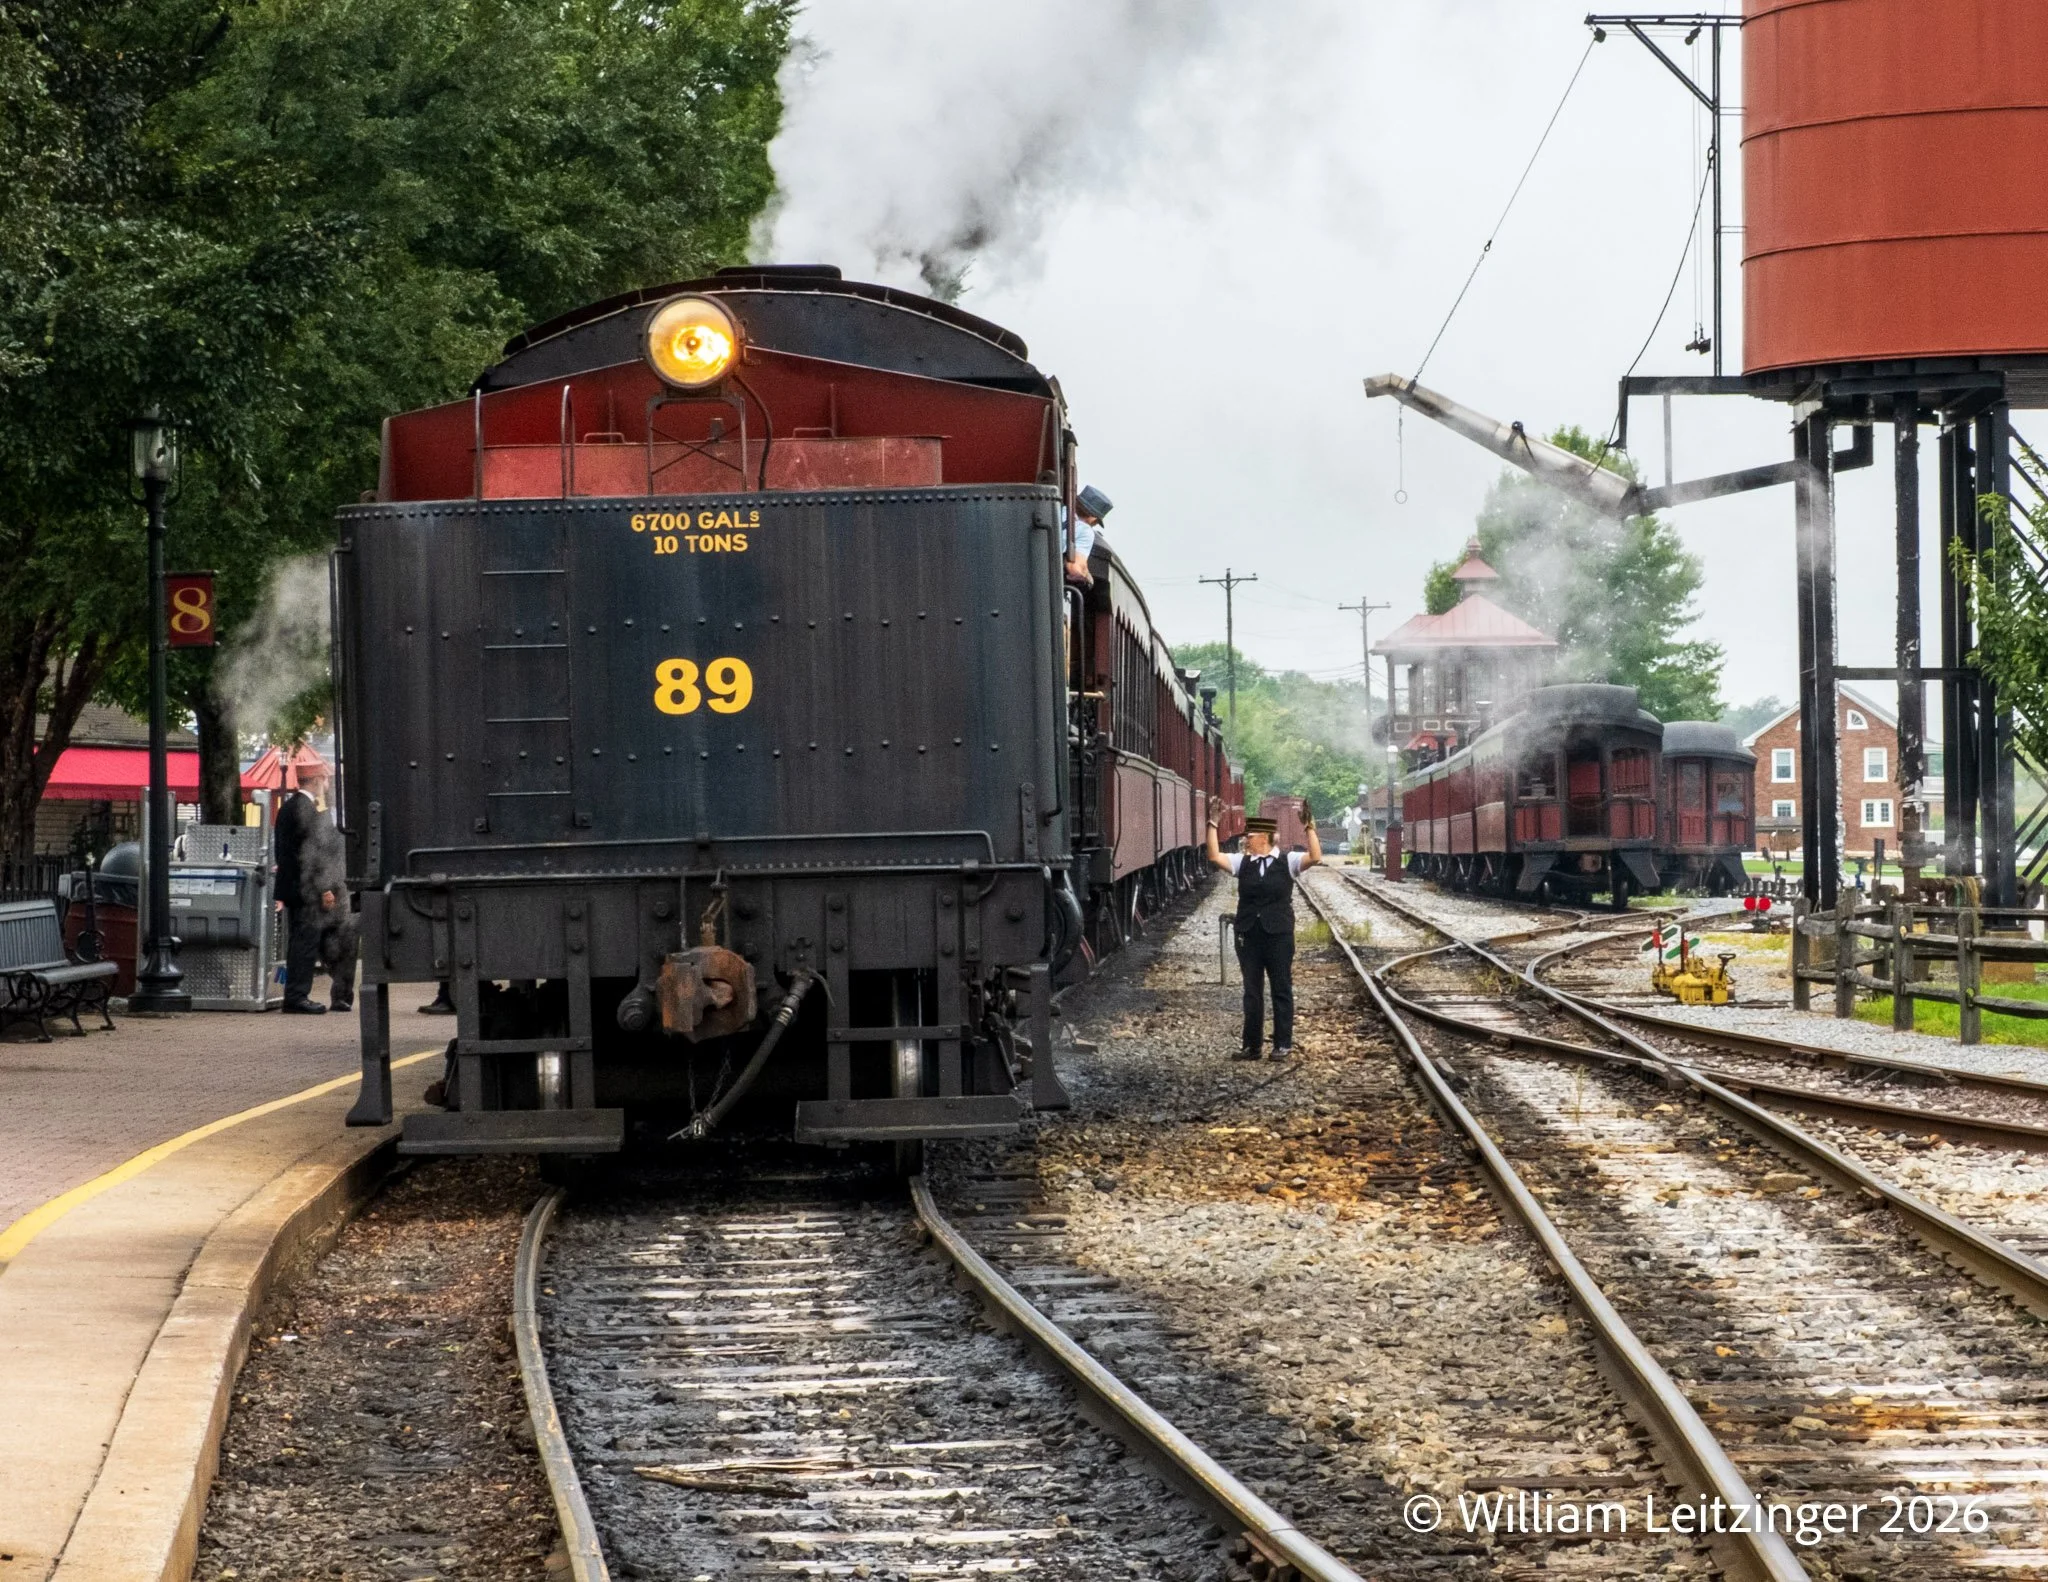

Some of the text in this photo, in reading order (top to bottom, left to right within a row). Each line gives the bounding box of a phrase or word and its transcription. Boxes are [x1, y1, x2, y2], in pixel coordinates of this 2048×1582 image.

[630, 512, 692, 533] 6700
[653, 533, 749, 555] 10 TONS
[171, 587, 211, 634] 8
[653, 656, 754, 716] 89
